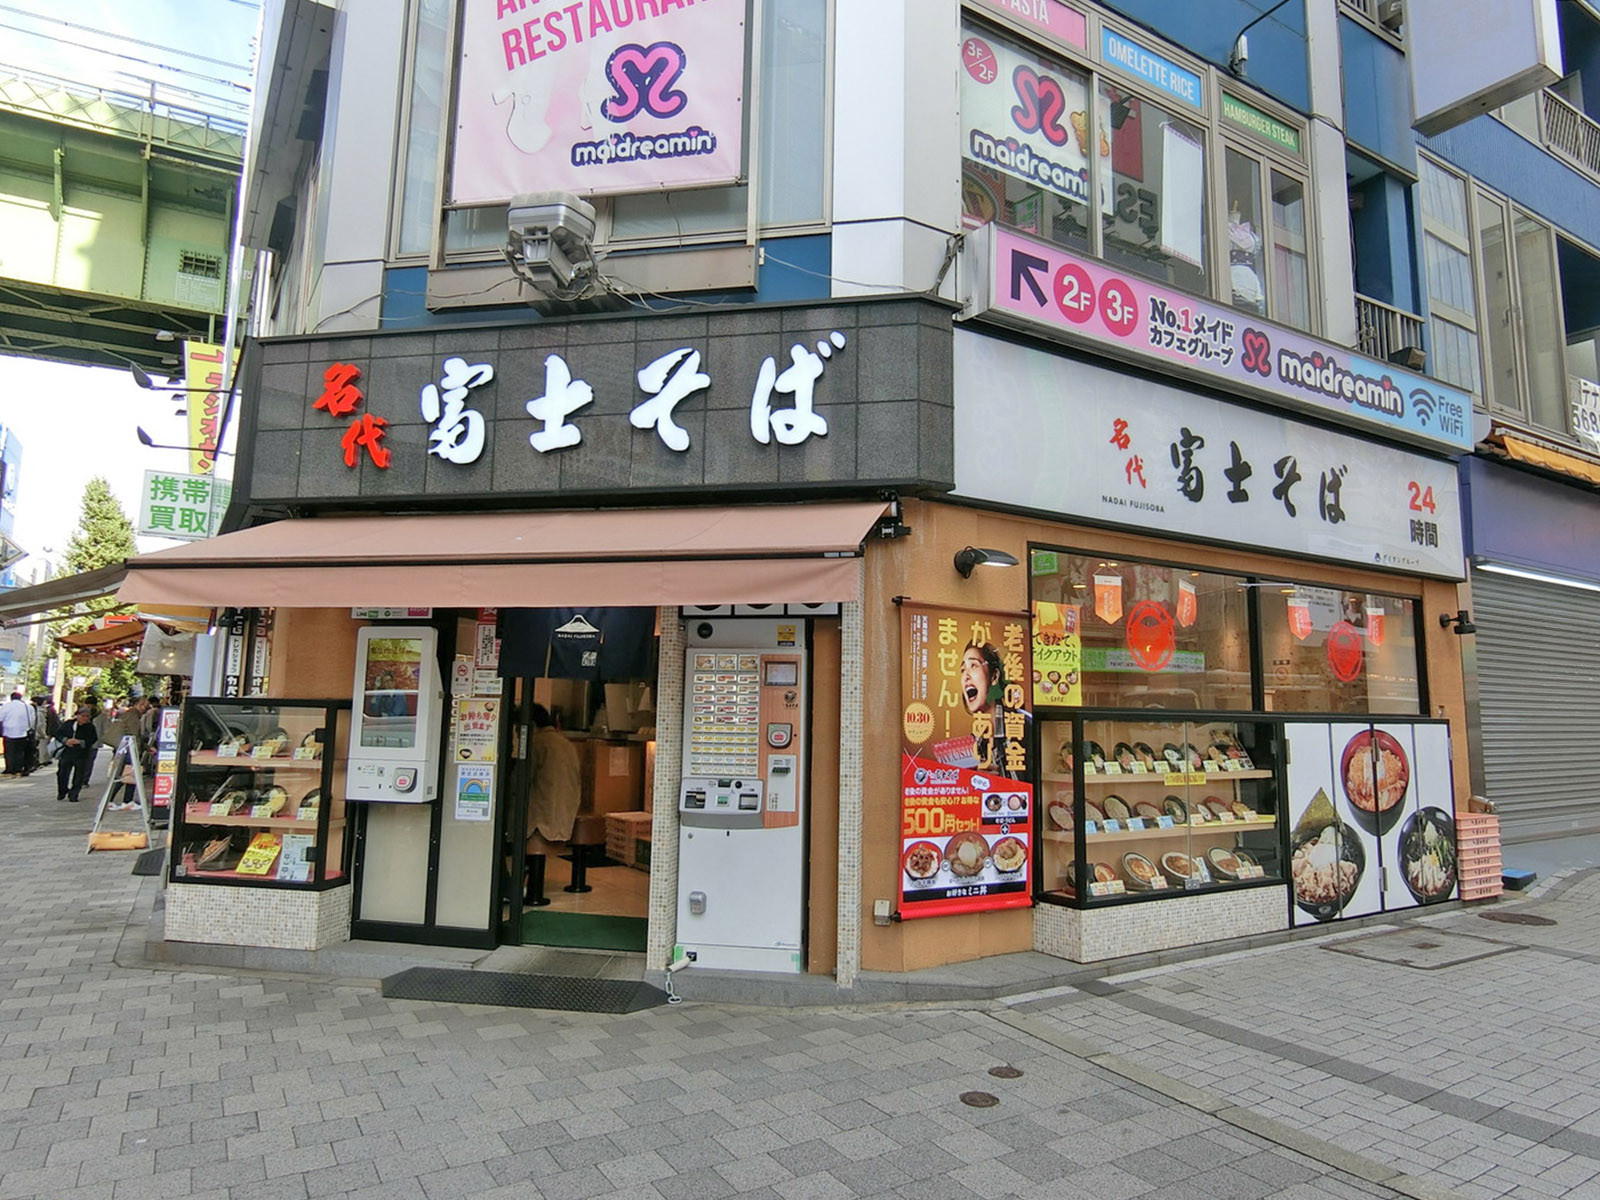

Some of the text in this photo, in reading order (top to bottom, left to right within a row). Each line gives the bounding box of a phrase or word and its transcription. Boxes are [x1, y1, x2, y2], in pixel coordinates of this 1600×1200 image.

[967, 40, 983, 59] 3F
[979, 63, 994, 81] 2F
[1108, 36, 1195, 102] OMELETTE RICE
[1223, 101, 1296, 148] HAMBURGER STEAK
[575, 130, 714, 164] maidreamin
[973, 133, 1089, 197] maidreami
[1062, 274, 1134, 325] 2F 3F
[1149, 324, 1234, 366] カフェグループ
[420, 331, 847, 465] 富士そば
[1280, 352, 1404, 415] maidreamin
[1438, 395, 1463, 419] Free
[1439, 414, 1464, 438] WiFi
[151, 475, 210, 505] 携帯
[1170, 427, 1348, 525] 富士そば
[1102, 495, 1166, 513] NADAI FUJISOBA
[1407, 481, 1437, 515] 24
[149, 505, 207, 534] 買取
[1409, 519, 1439, 549] 時間
[1003, 622, 1026, 772] 老後の資金
